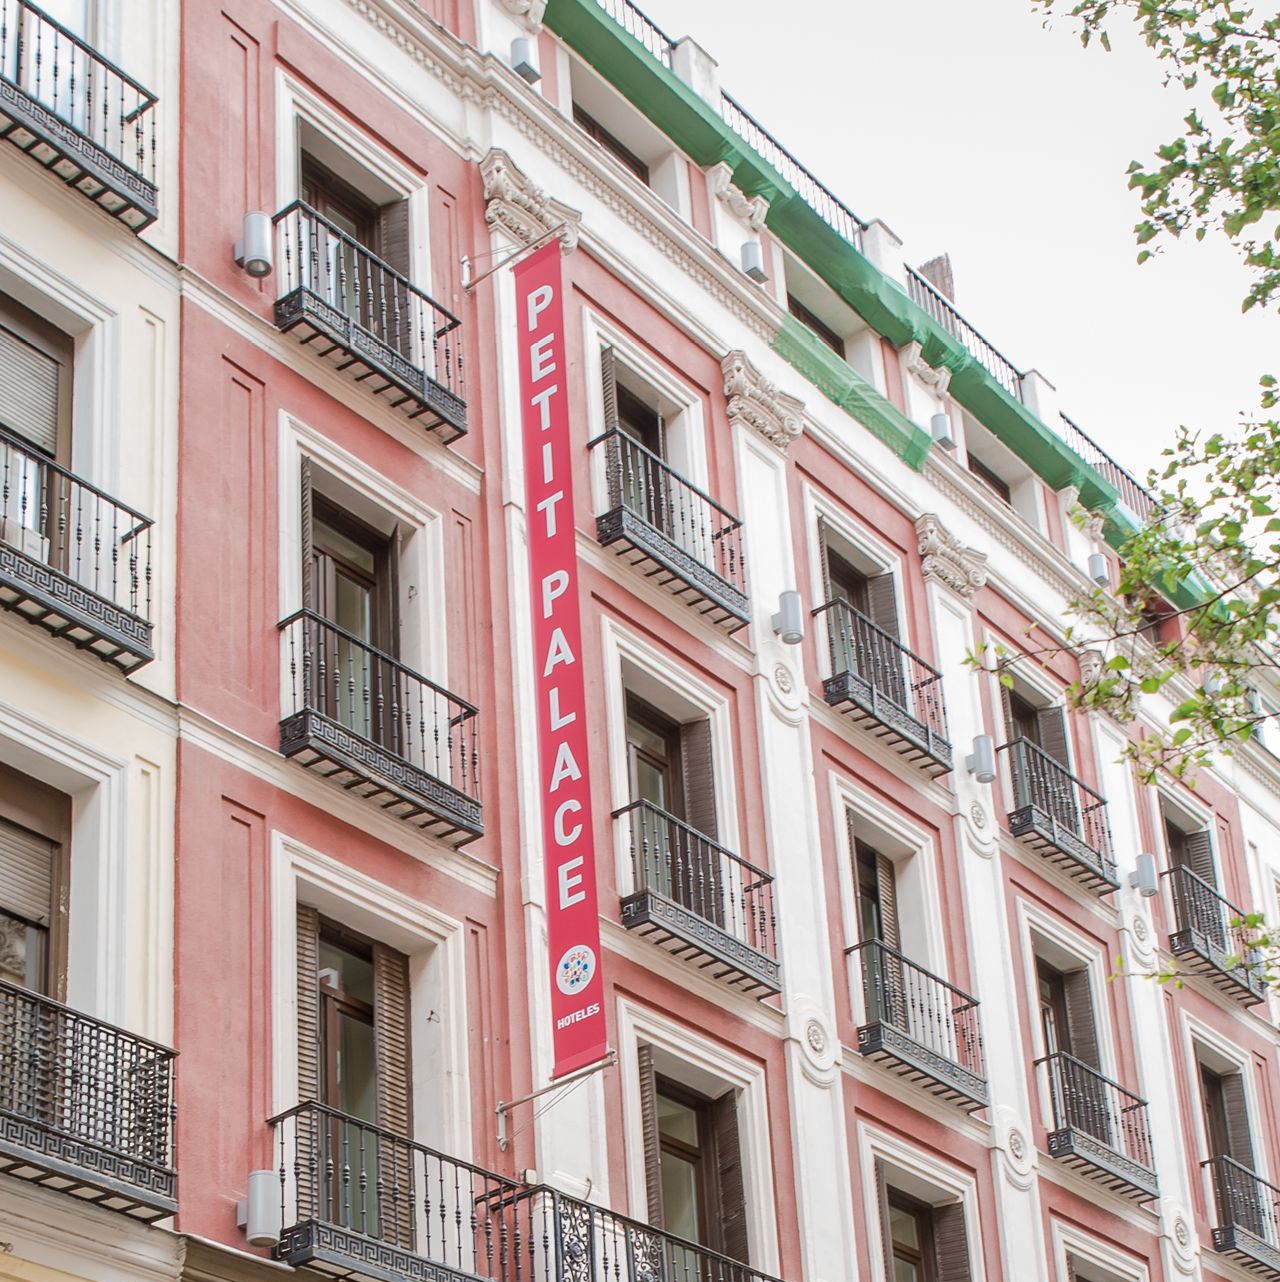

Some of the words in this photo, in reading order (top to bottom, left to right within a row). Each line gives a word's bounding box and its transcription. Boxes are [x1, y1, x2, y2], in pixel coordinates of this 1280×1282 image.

[526, 284, 564, 538] PETIT
[541, 568, 587, 911] PALACE
[556, 1002, 601, 1030] HOTELES
